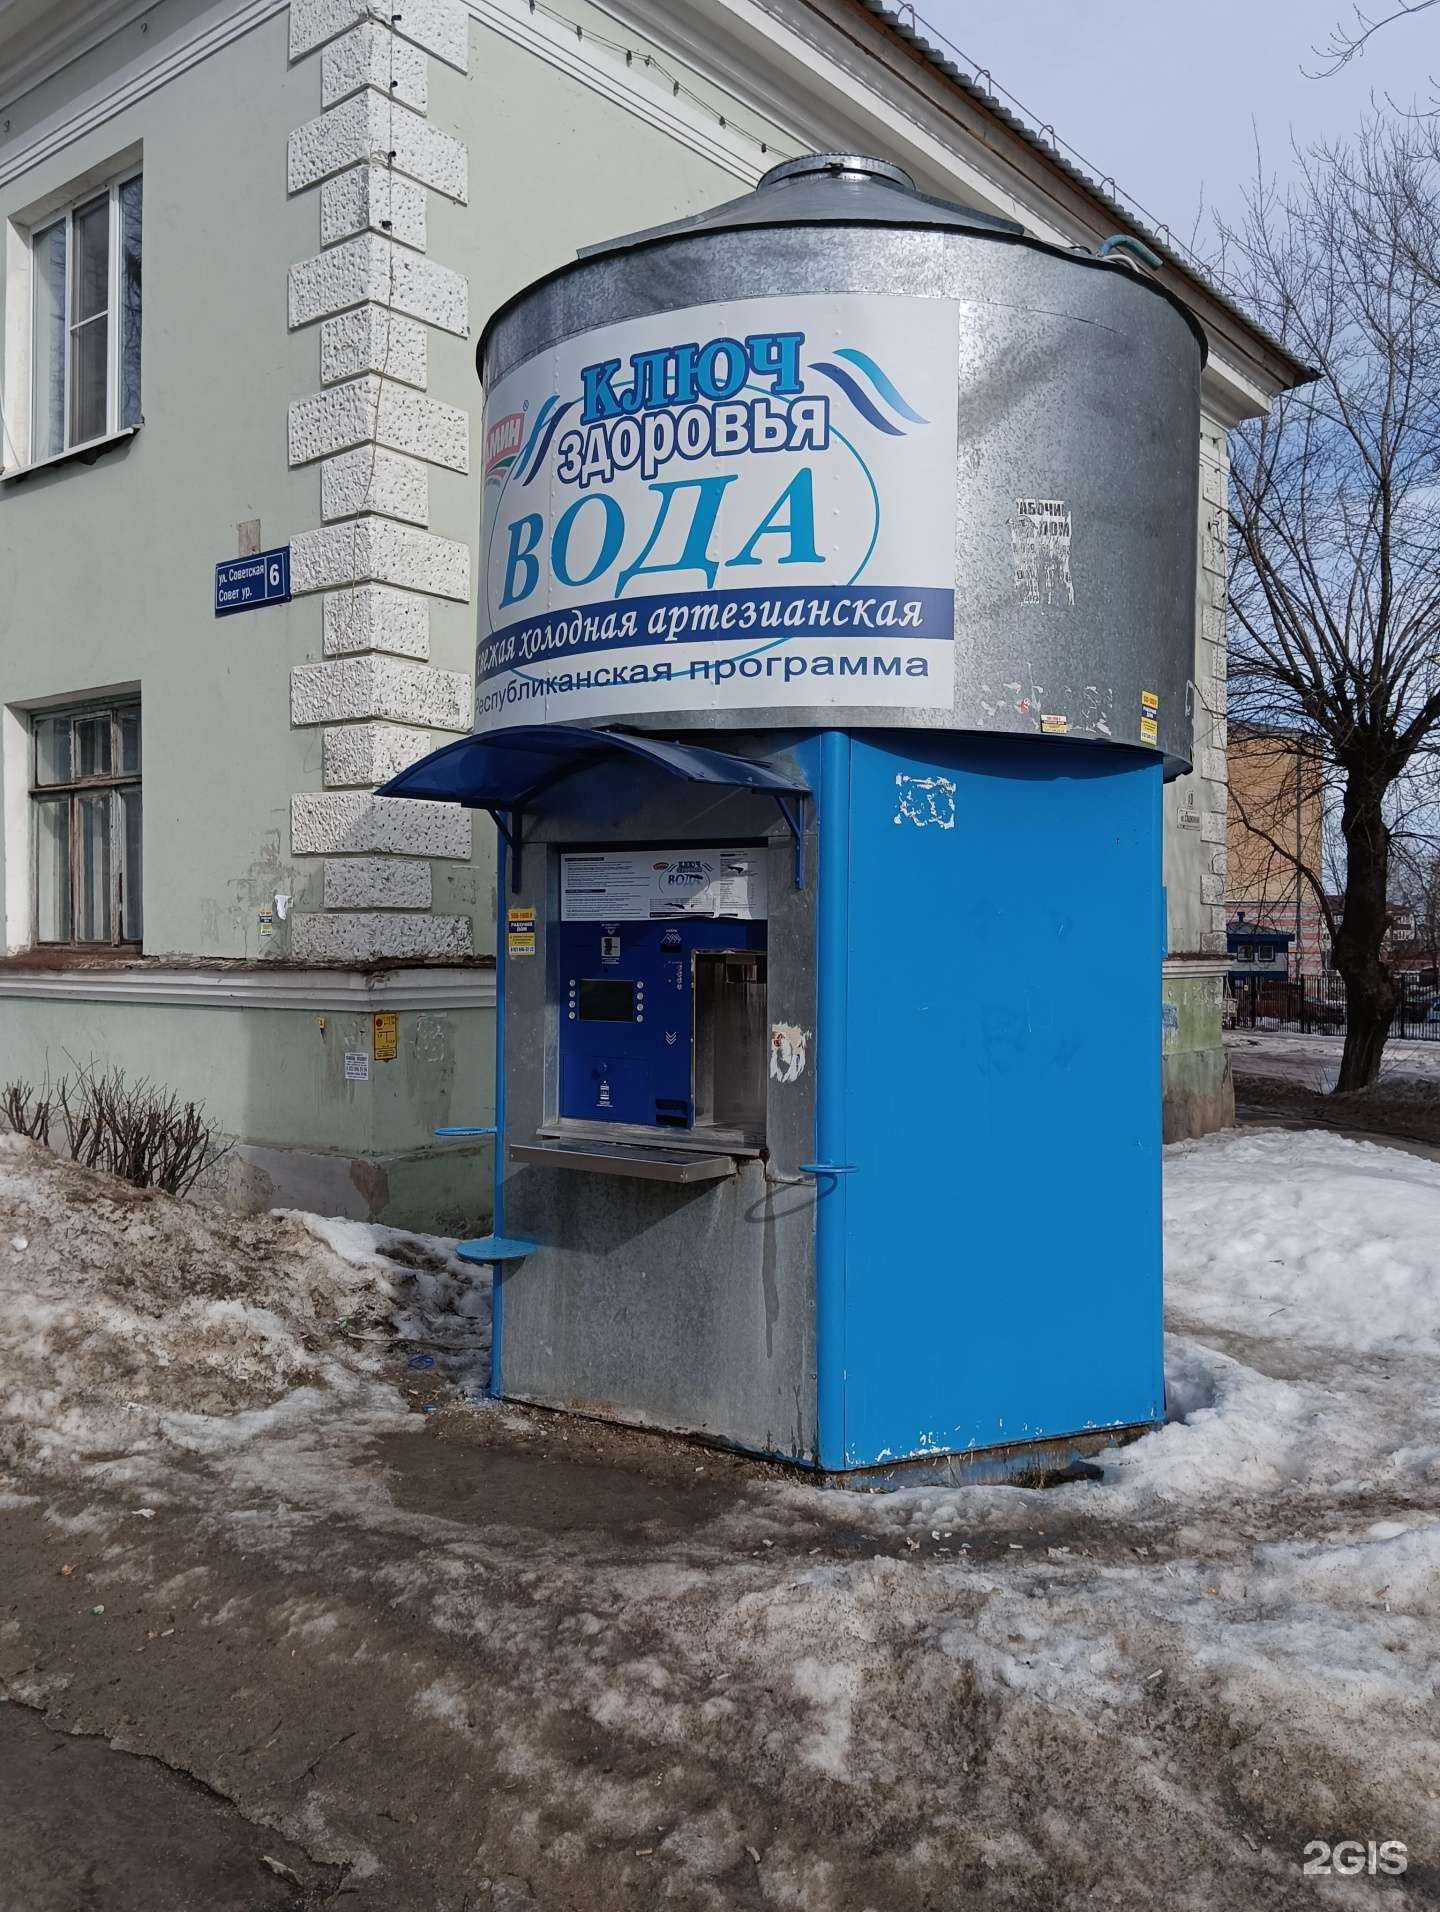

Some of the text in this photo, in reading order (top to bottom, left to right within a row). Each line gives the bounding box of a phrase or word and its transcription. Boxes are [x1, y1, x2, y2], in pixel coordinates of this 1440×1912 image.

[580, 332, 805, 425] КЛЮЧ
[557, 395, 830, 489] ЗДОРОВЬЯ
[498, 467, 826, 610] ВОДА
[218, 586, 253, 602] Совет ур.
[229, 565, 264, 581] Советская
[269, 563, 280, 586] 6
[519, 609, 638, 660] холодная
[647, 596, 924, 642] артезианская
[689, 654, 929, 684] программа
